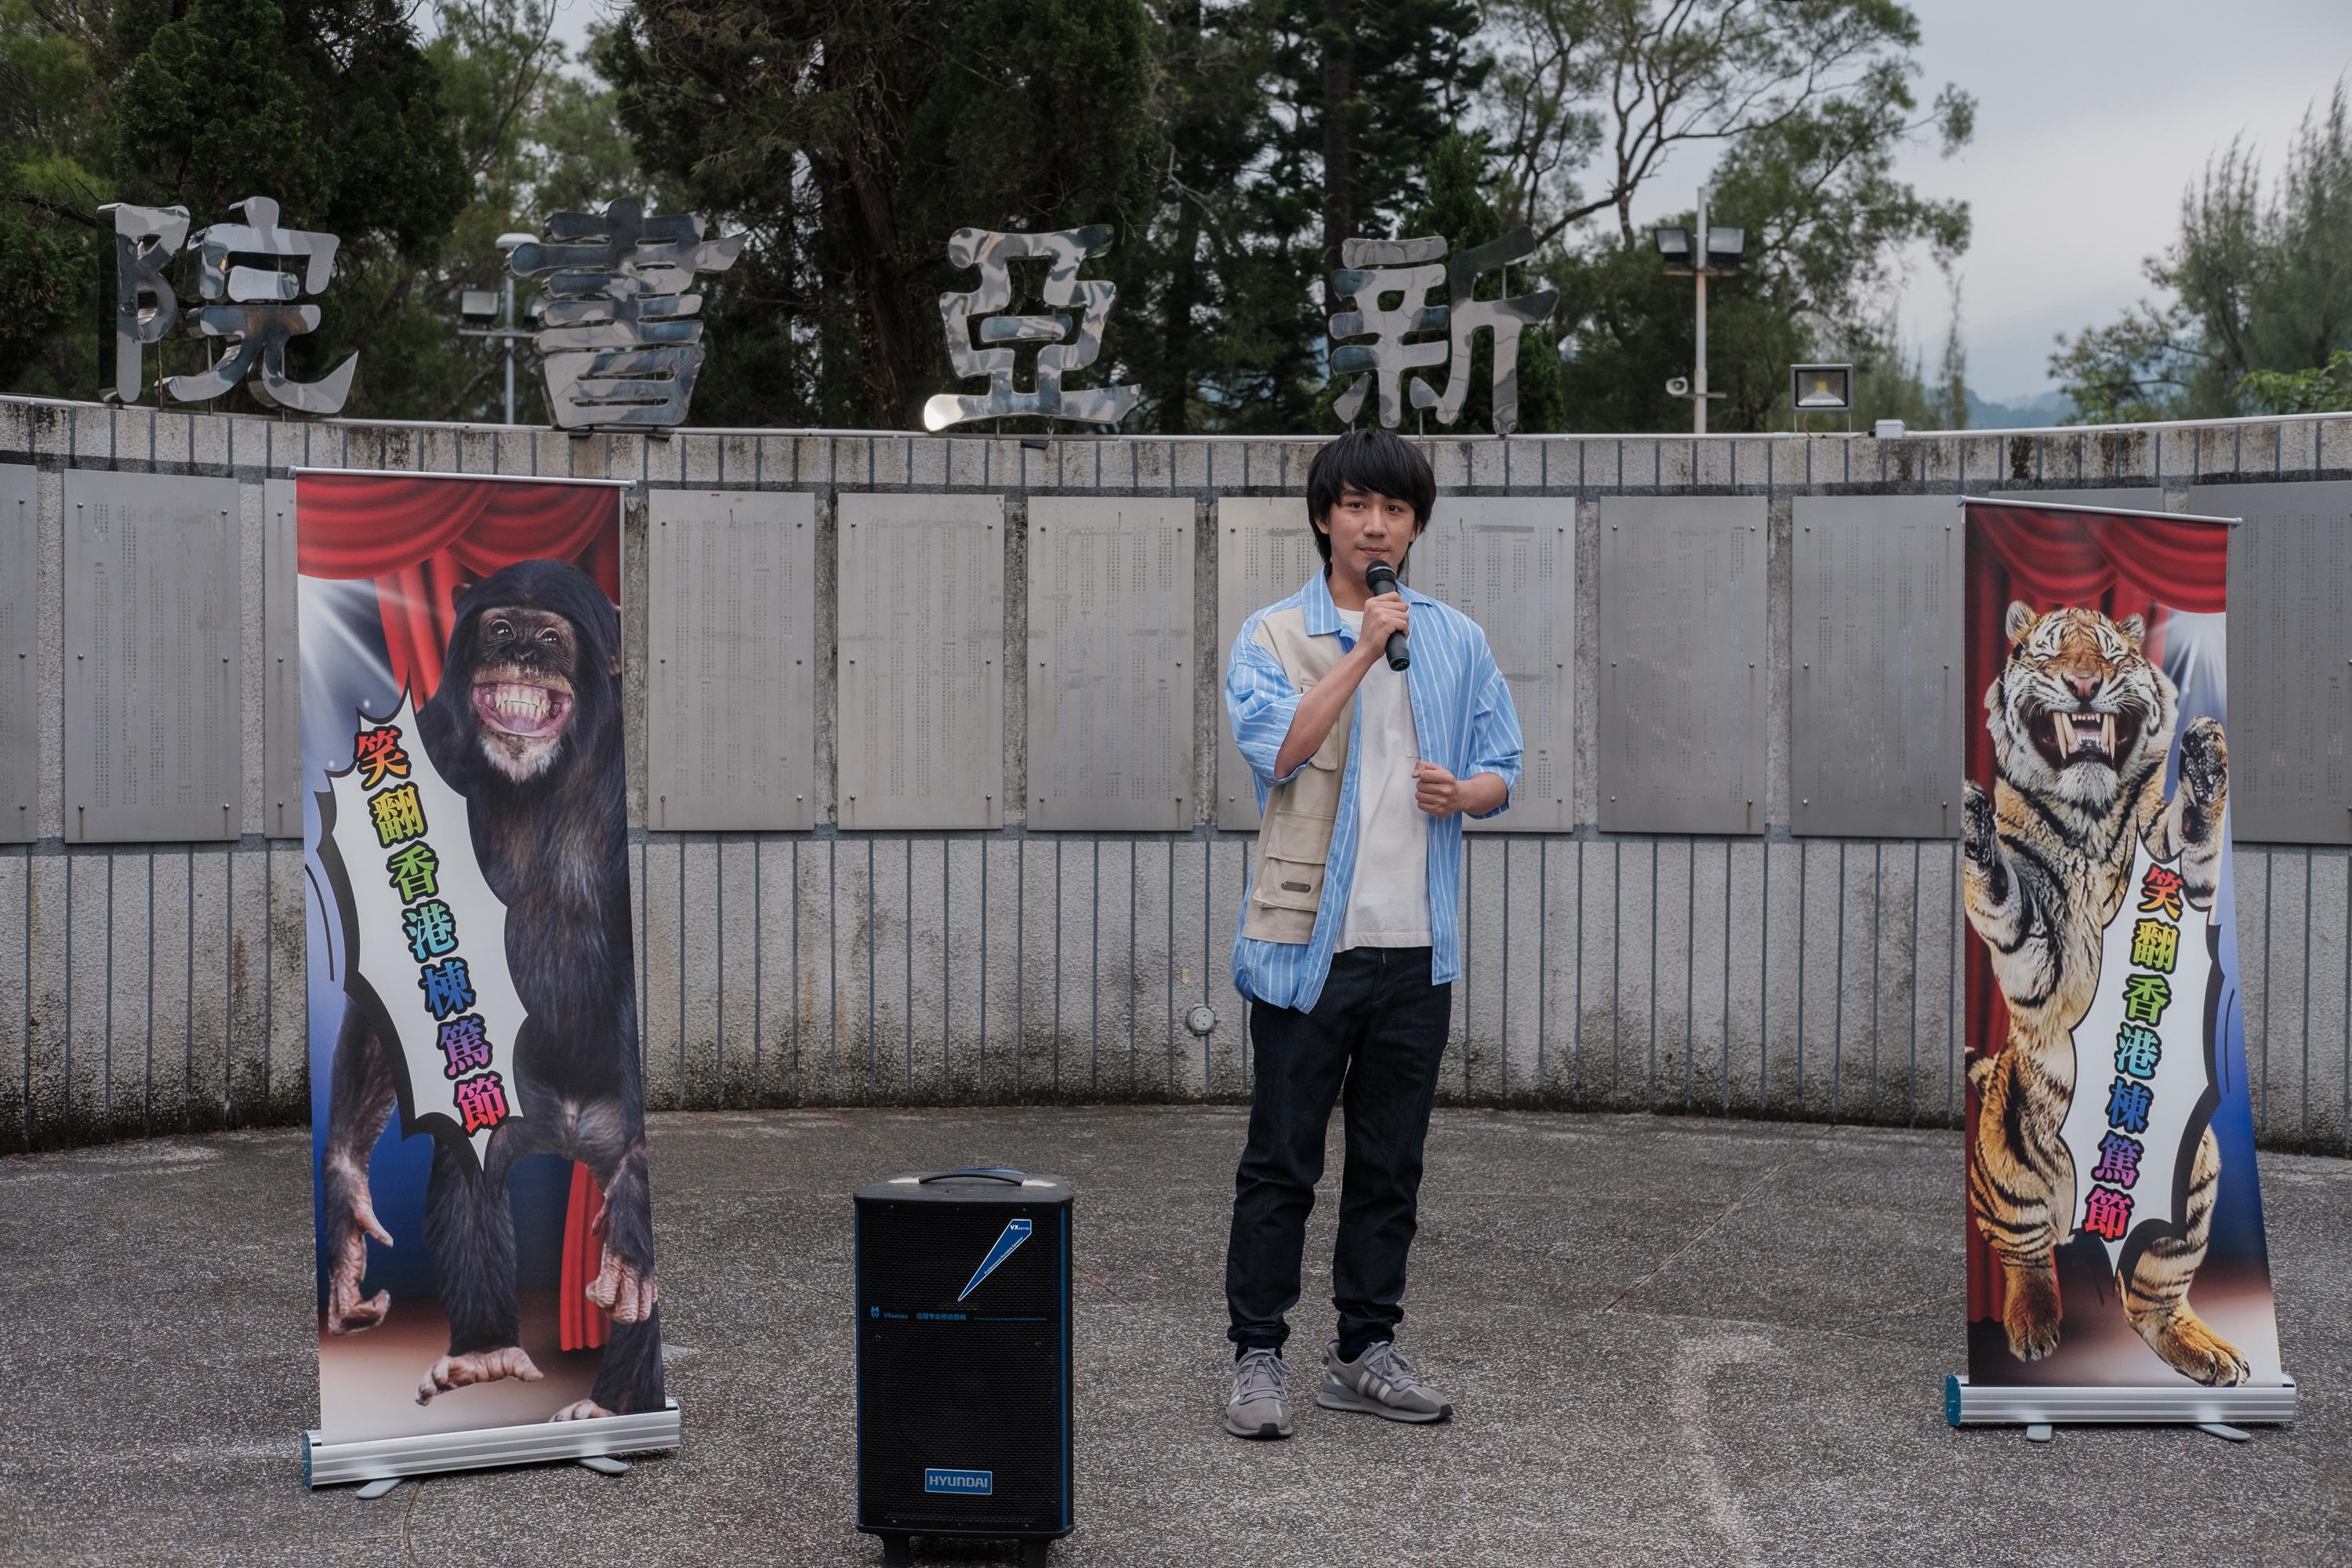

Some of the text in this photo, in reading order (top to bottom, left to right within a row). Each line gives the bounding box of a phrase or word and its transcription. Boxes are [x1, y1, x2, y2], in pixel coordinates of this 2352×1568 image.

[355, 726, 509, 1137] 笑翻香港棟篤節
[2082, 863, 2186, 1241] 笑翻香港棟篤節
[929, 1475, 988, 1488] HYUNDAI
